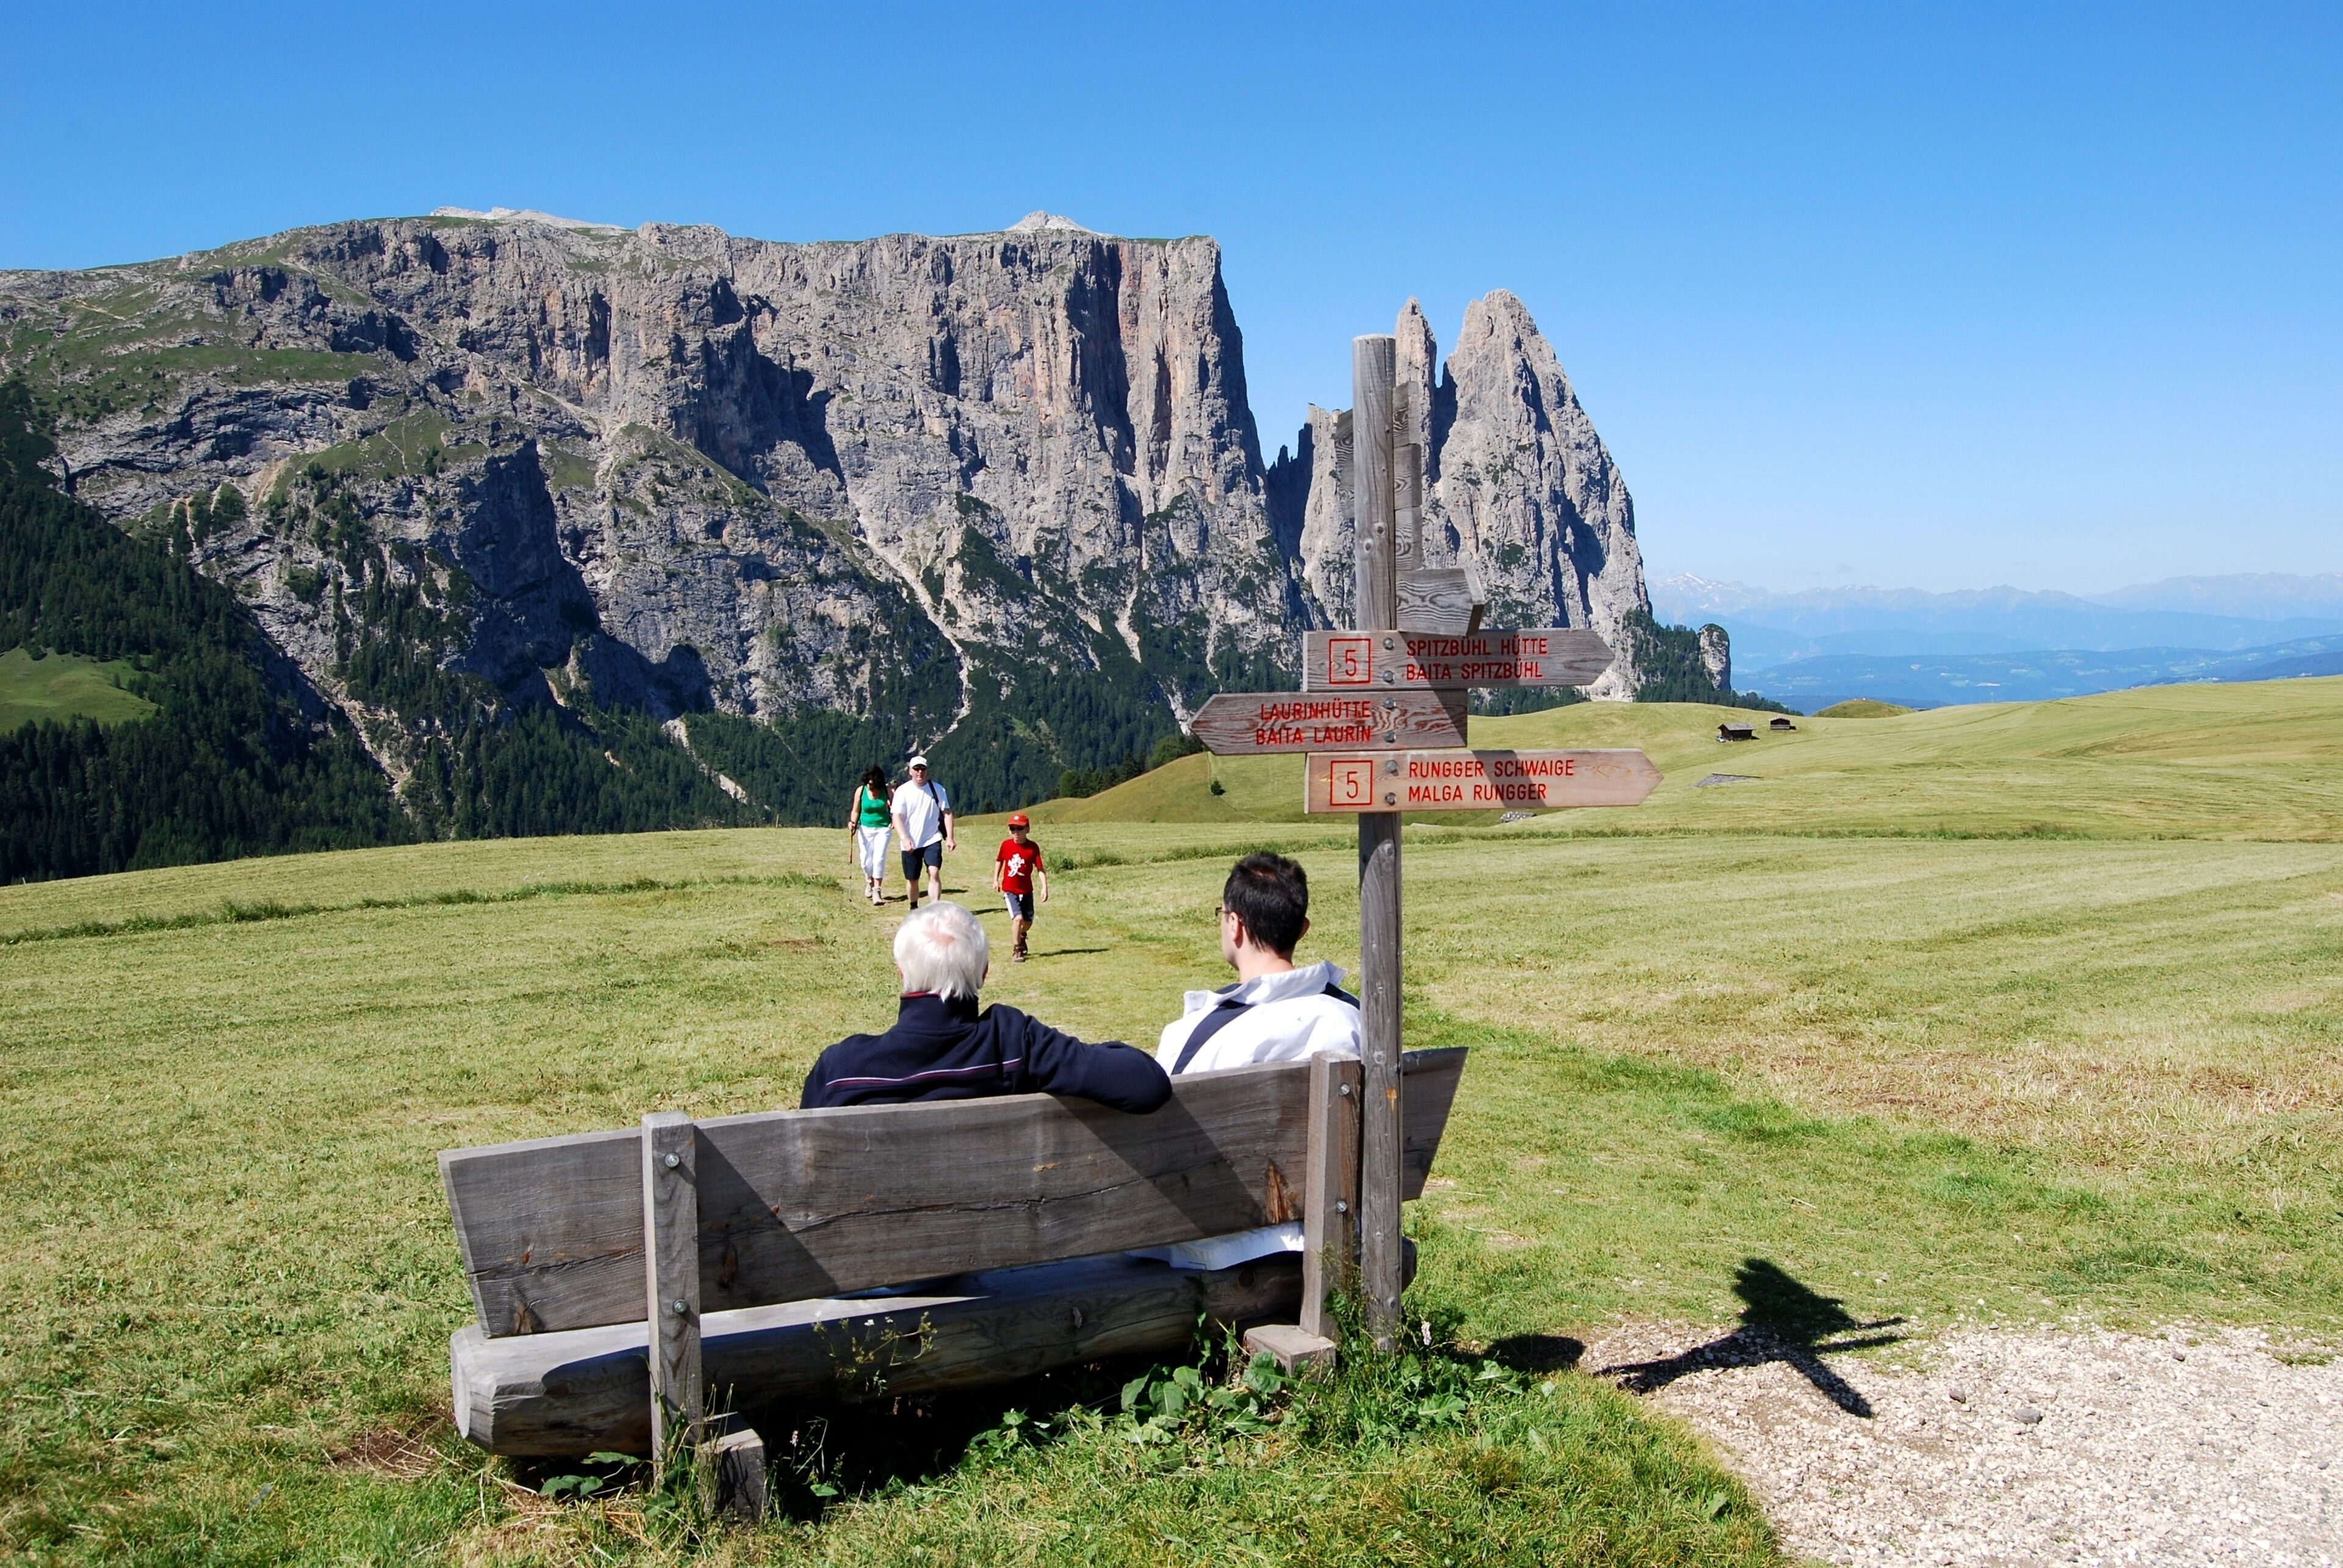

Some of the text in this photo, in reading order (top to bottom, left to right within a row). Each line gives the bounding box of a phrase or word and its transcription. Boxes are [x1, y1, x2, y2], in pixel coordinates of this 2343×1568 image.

[1406, 635, 1548, 656] SPITZBÜHL HÜTTE
[1345, 649, 1357, 677] 5
[1406, 658, 1543, 680] BAITA SPITZBÜHL
[1261, 697, 1371, 721] LAURINHÜTTE
[1256, 725, 1372, 745] BAITA LAURIN
[1409, 759, 1575, 778] RUNGGER SCHWAIGE
[1346, 771, 1358, 799] 5
[1408, 783, 1546, 802] MALGA RUNGGER
